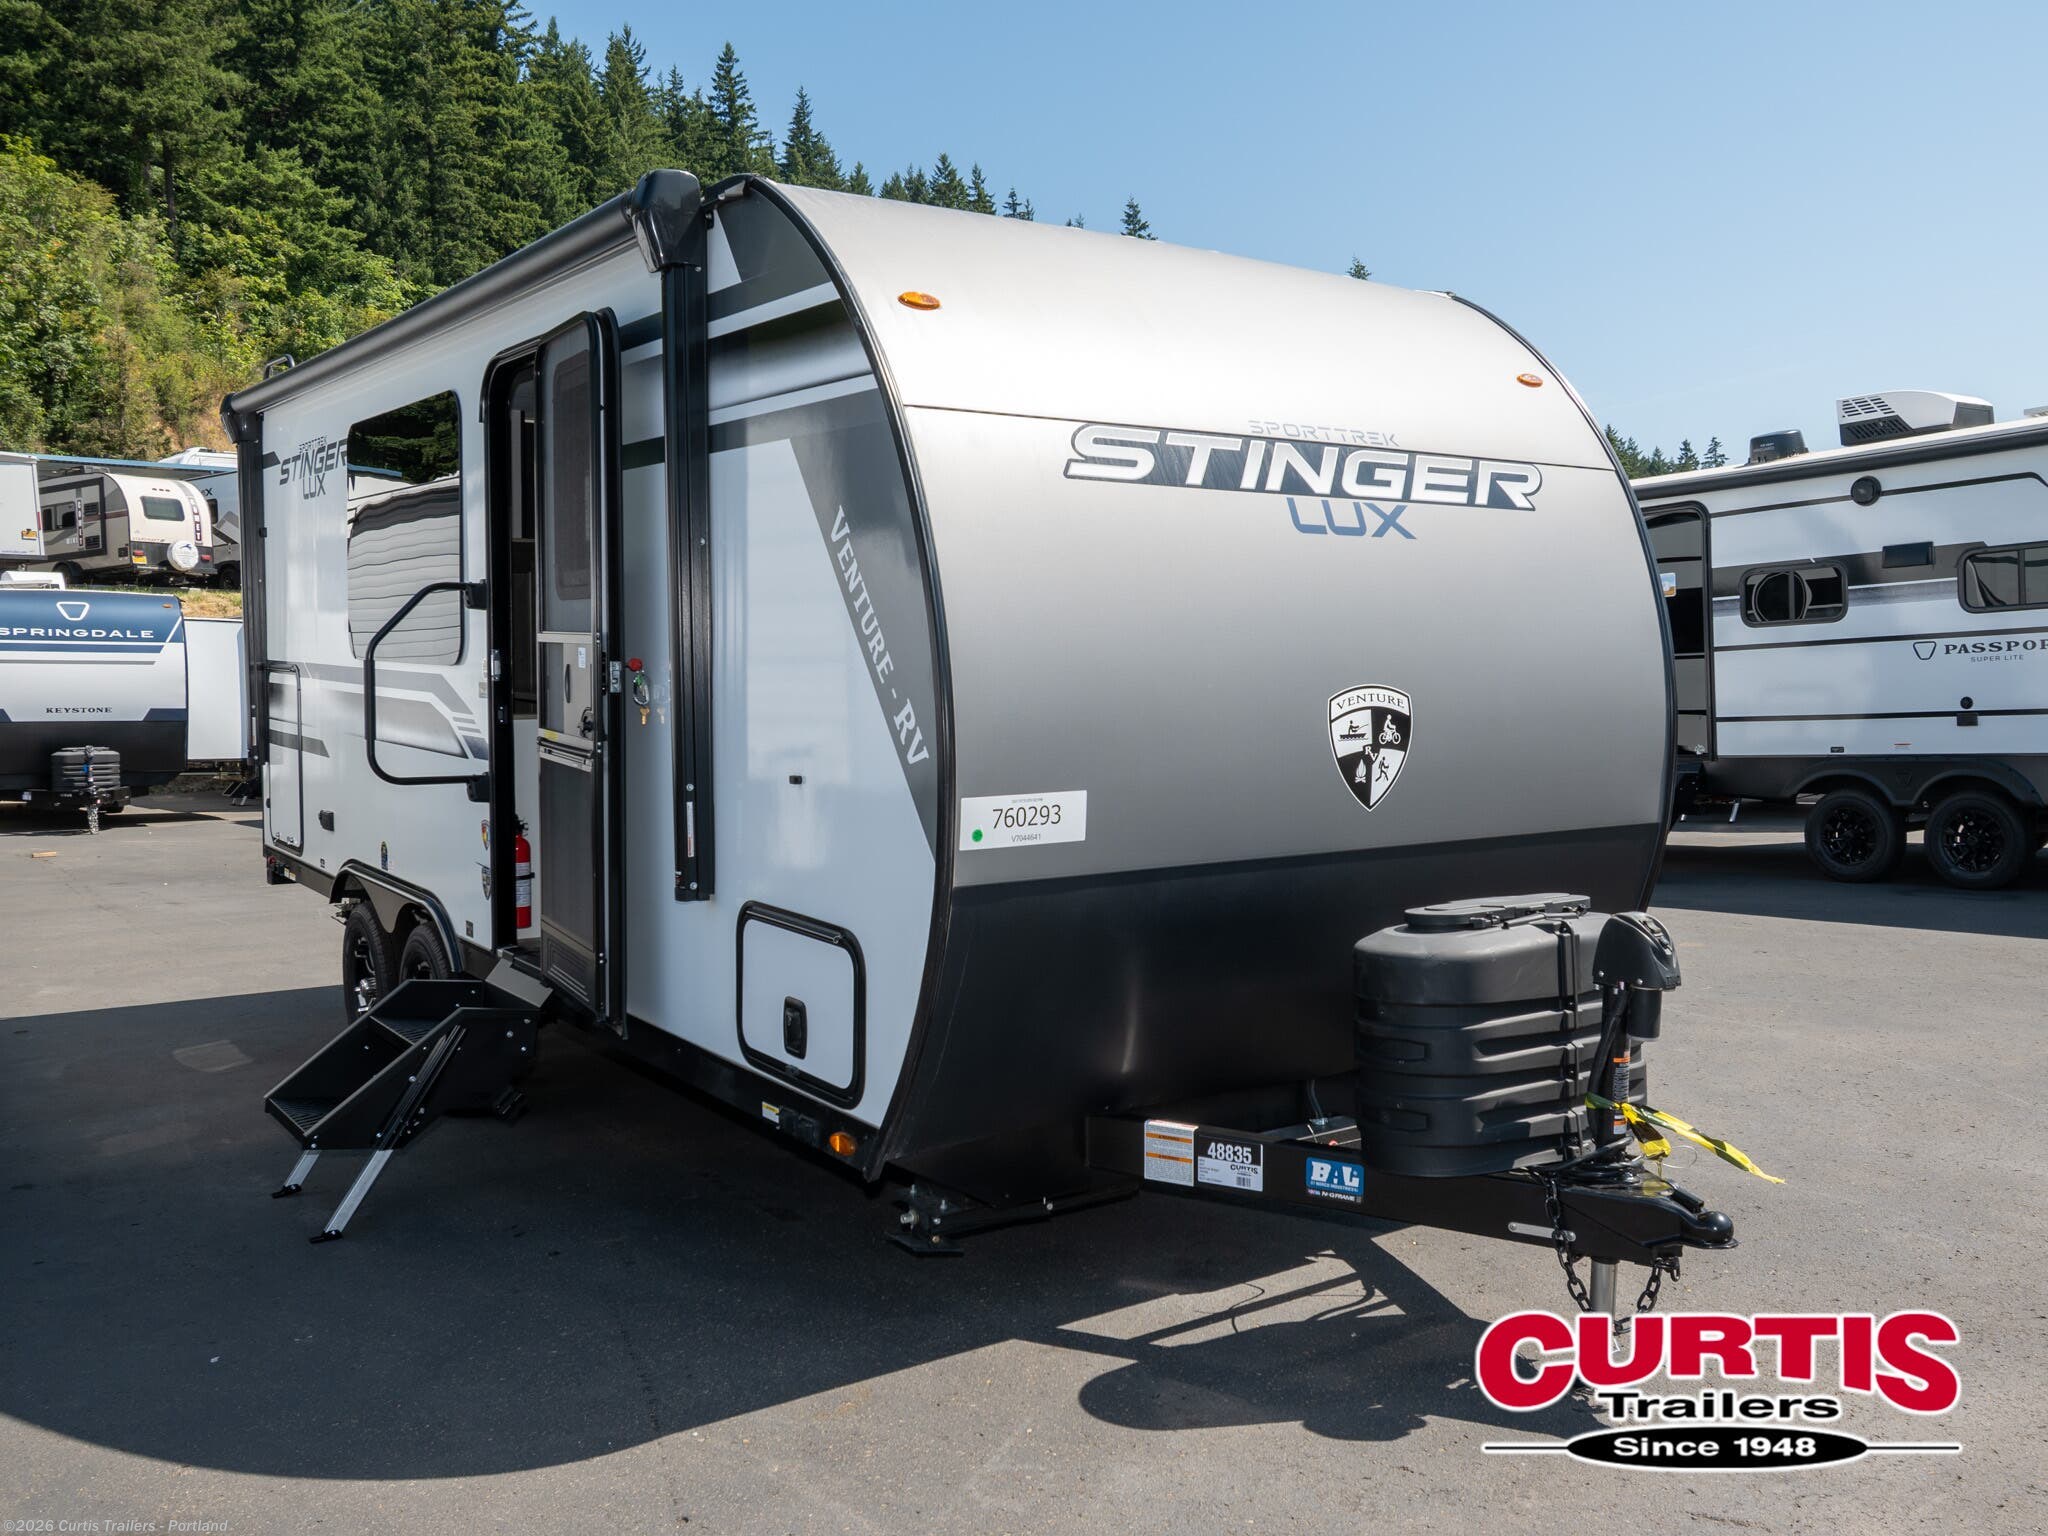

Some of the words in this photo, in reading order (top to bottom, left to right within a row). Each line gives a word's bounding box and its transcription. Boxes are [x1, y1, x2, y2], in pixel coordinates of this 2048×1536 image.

[1247, 420, 1400, 448] SPORTTREK
[280, 438, 347, 485] STINGER
[1064, 423, 1542, 510] STINGER
[303, 473, 326, 500] LUX
[1286, 496, 1417, 540] LUX
[0, 627, 155, 639] SPRINGDALE
[830, 504, 894, 684] VENTURE
[893, 698, 930, 765] RV
[1971, 655, 2001, 663] SUPER
[1336, 693, 1406, 710] VENTURE
[1365, 745, 1378, 762] RV
[992, 804, 1062, 830] 760293
[1207, 1142, 1252, 1165] 48835
[1230, 1163, 1259, 1175] CURTIS
